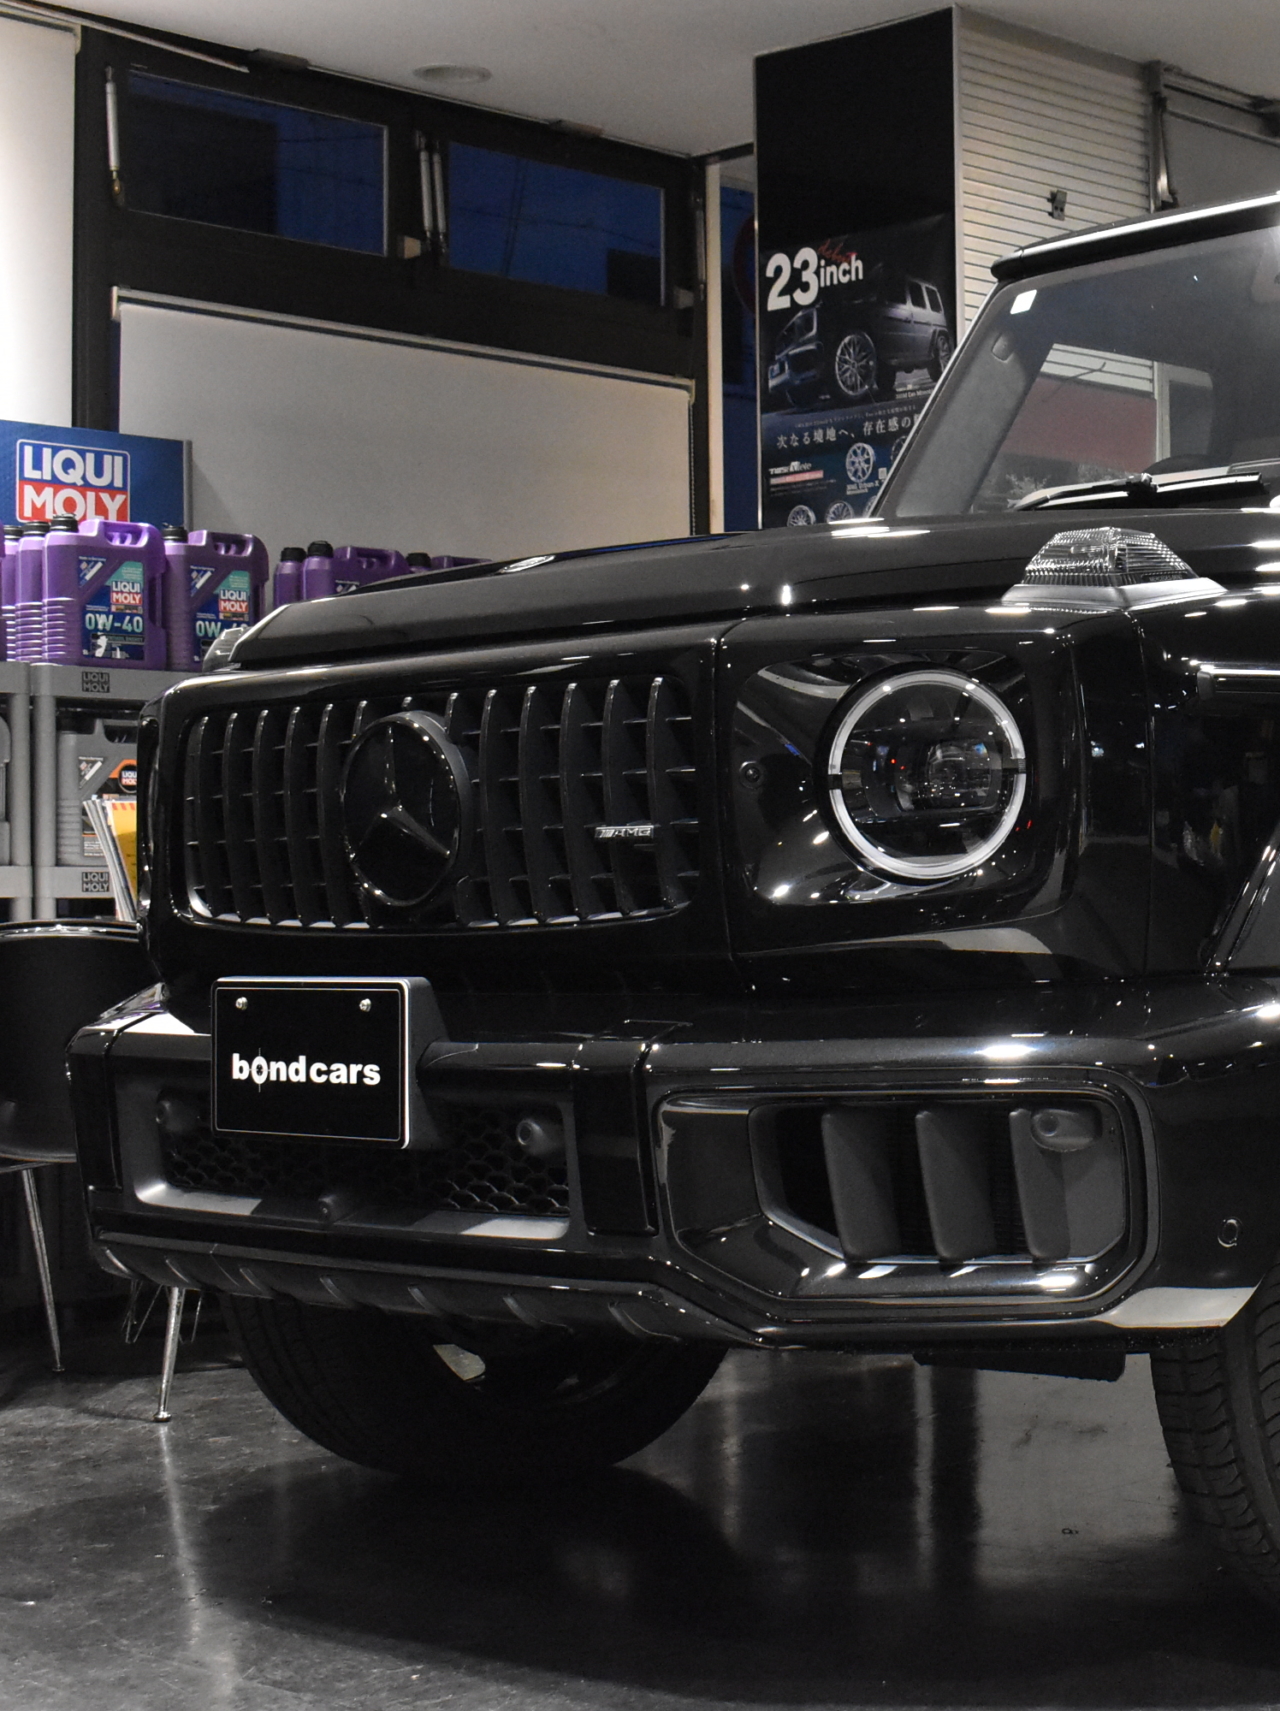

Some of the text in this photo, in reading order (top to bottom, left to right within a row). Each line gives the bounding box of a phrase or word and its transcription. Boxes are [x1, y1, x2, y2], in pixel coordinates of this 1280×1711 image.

[24, 445, 123, 487] LIQUI
[24, 485, 126, 522] MOLY
[112, 581, 140, 593] LIQUI
[112, 593, 141, 604] MOLY
[220, 590, 247, 601] LIQUI
[220, 601, 248, 611] MOLY
[85, 613, 143, 633] 0W-40
[83, 672, 109, 682] LIQUI
[83, 682, 109, 692] MOLY
[121, 770, 138, 779] LIQU
[83, 872, 108, 882] LIQUI
[83, 882, 108, 892] MOLY
